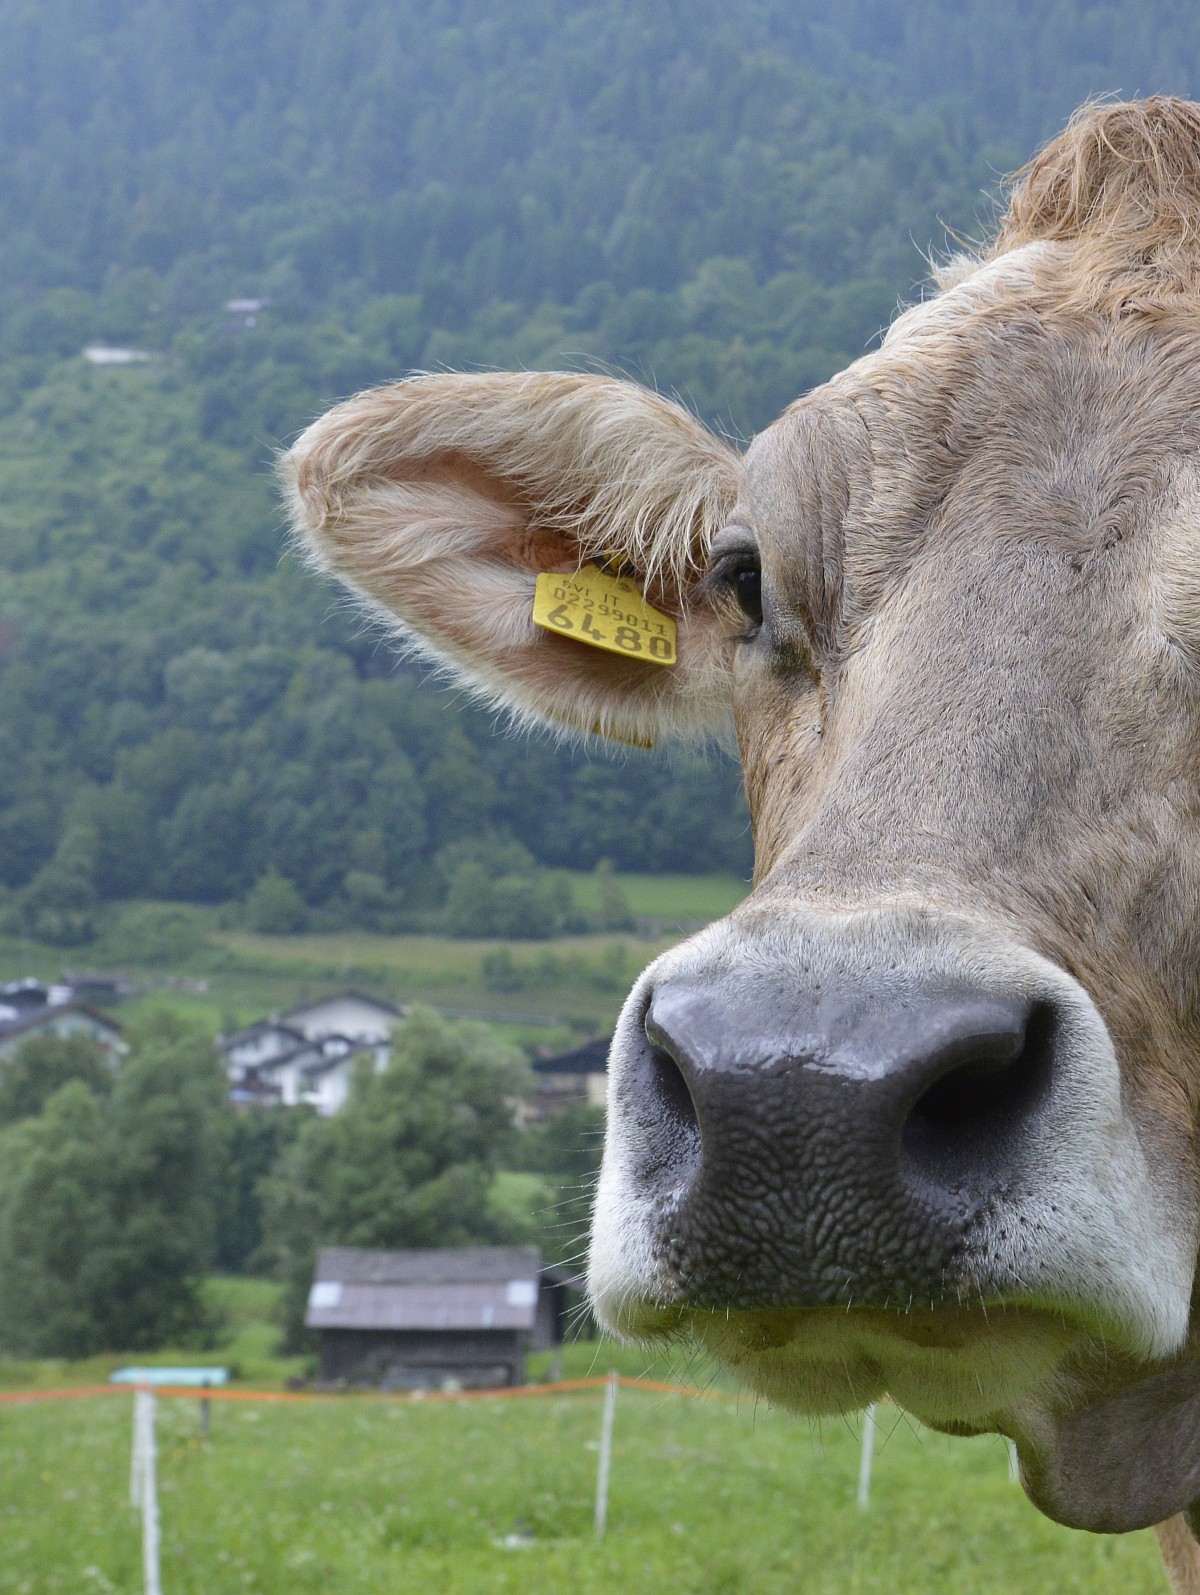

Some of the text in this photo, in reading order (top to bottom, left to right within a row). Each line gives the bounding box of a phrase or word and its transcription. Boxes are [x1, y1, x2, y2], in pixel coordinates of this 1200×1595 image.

[553, 587, 667, 636] 02299011
[604, 593, 620, 606] IT
[547, 604, 672, 659] 6480
